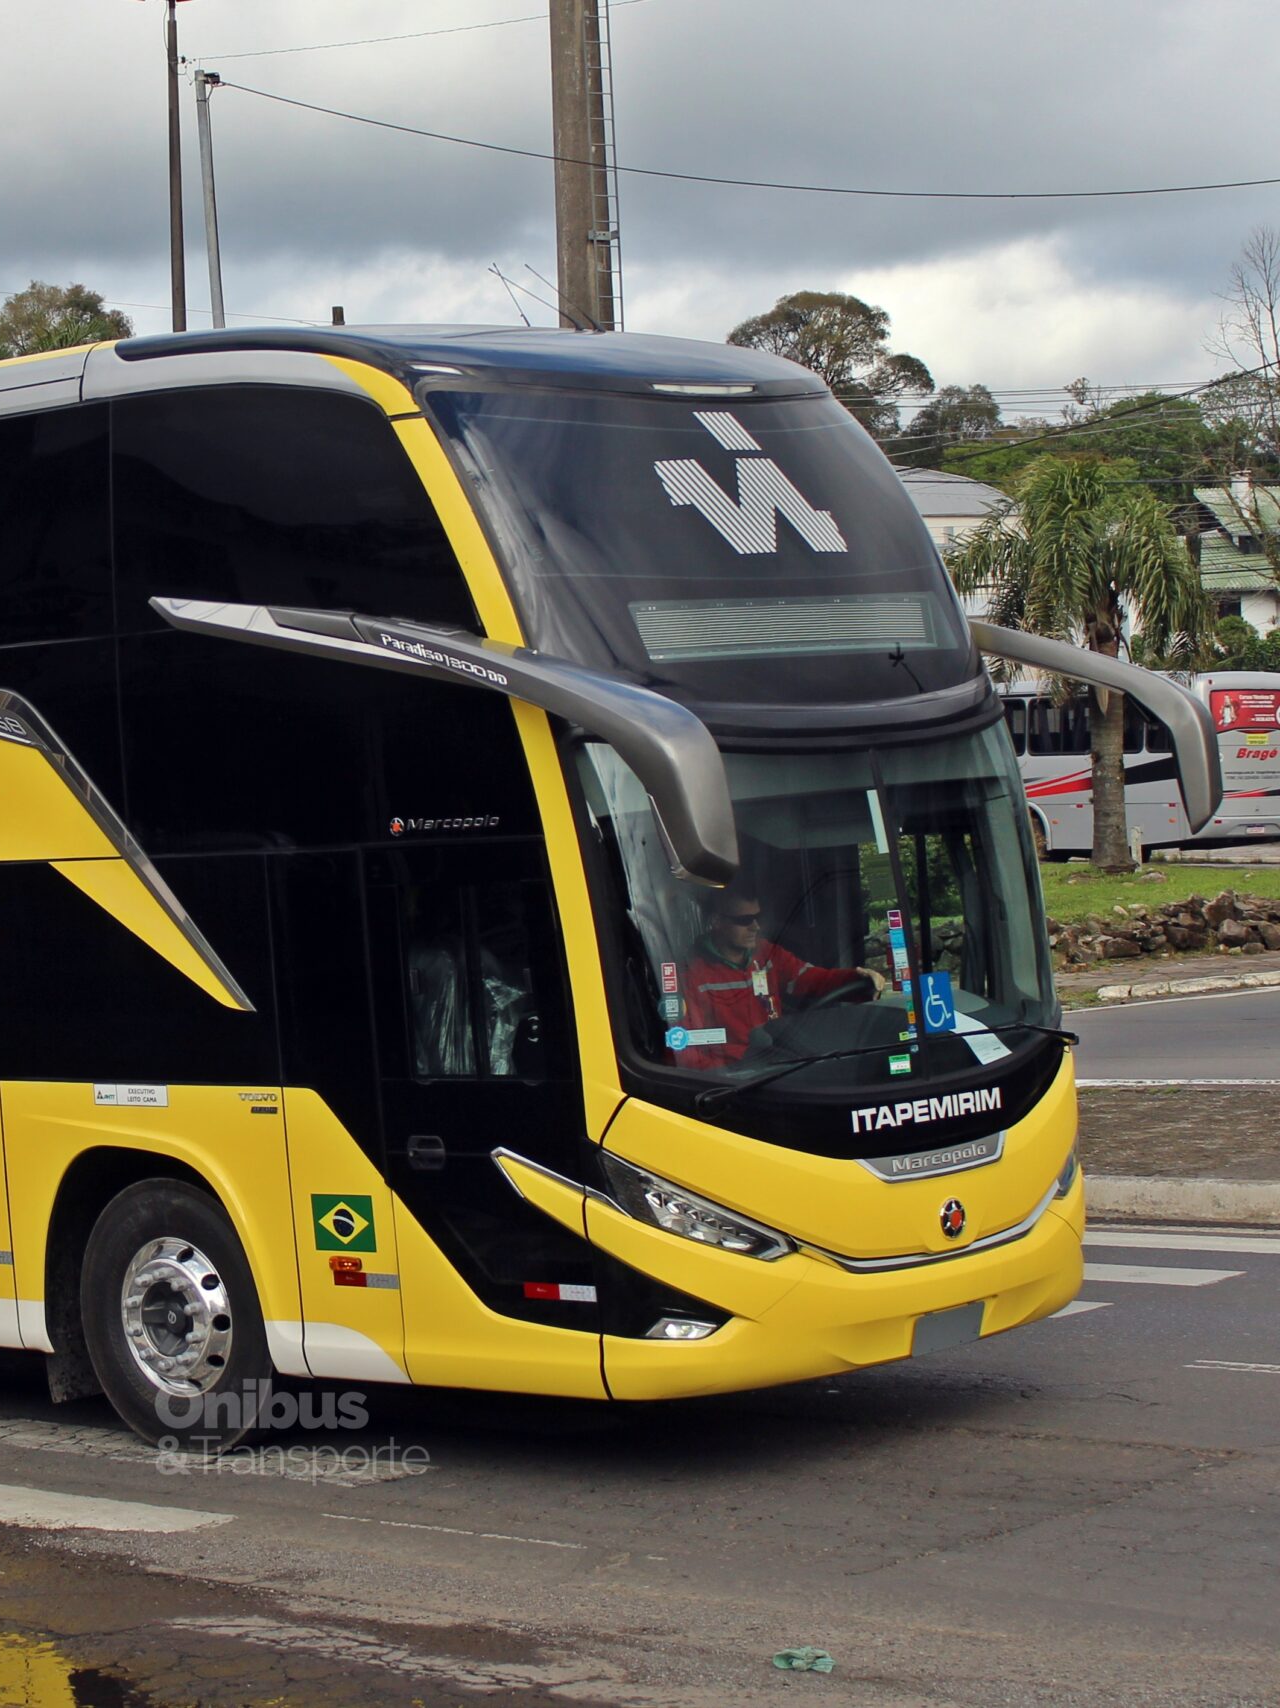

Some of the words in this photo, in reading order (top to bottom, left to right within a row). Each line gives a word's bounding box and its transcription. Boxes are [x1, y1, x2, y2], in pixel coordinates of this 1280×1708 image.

[380, 633, 443, 662] Paradiso
[407, 814, 500, 830] Marcopolo
[238, 1093, 278, 1102] VOLVO
[851, 1087, 1002, 1133] ITAPEMIRIM
[892, 1144, 987, 1173] Marcopolo
